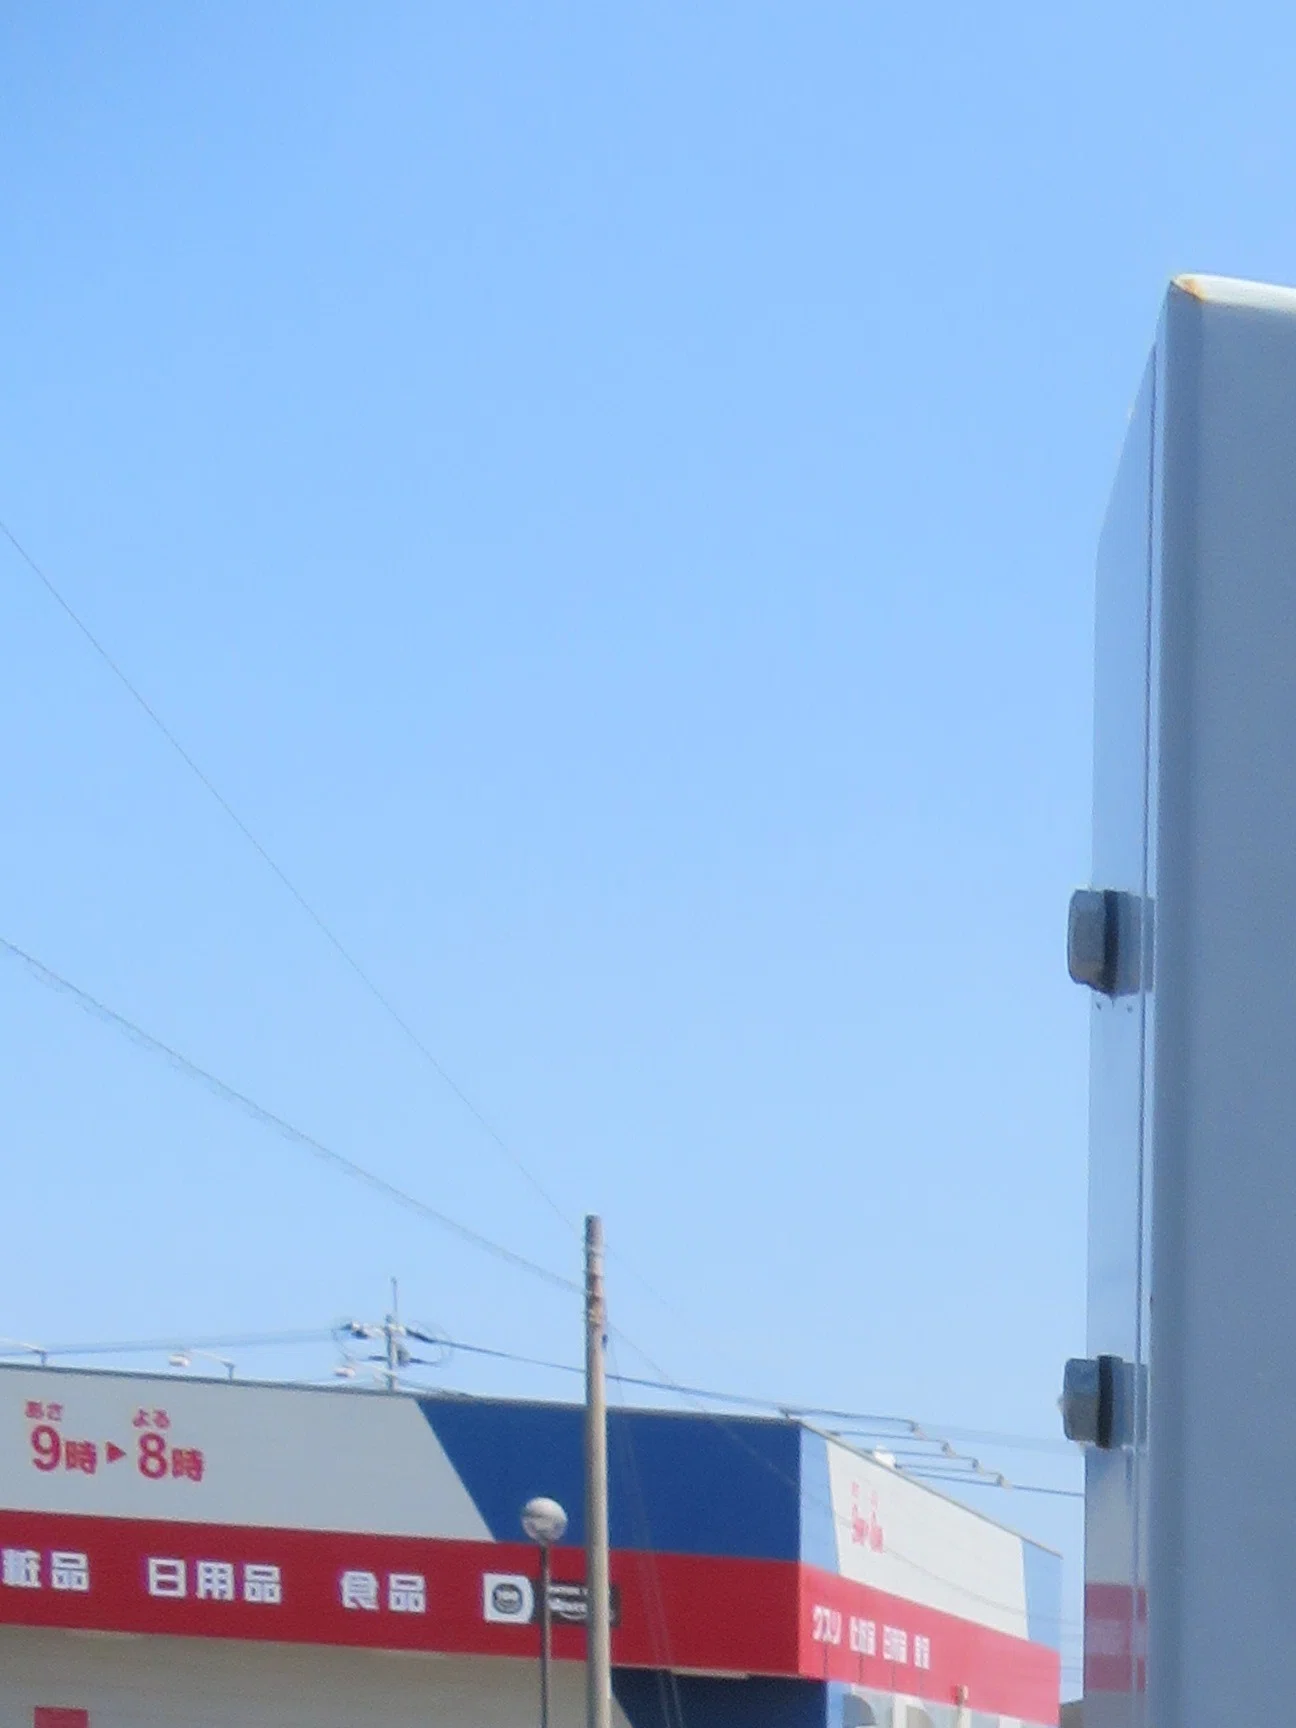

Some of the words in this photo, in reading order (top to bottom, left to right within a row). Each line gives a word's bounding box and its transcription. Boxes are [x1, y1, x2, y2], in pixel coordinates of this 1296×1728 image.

[132, 1408, 170, 1429] よる
[148, 1556, 282, 1604] 日用品
[340, 1571, 427, 1613] 食品
